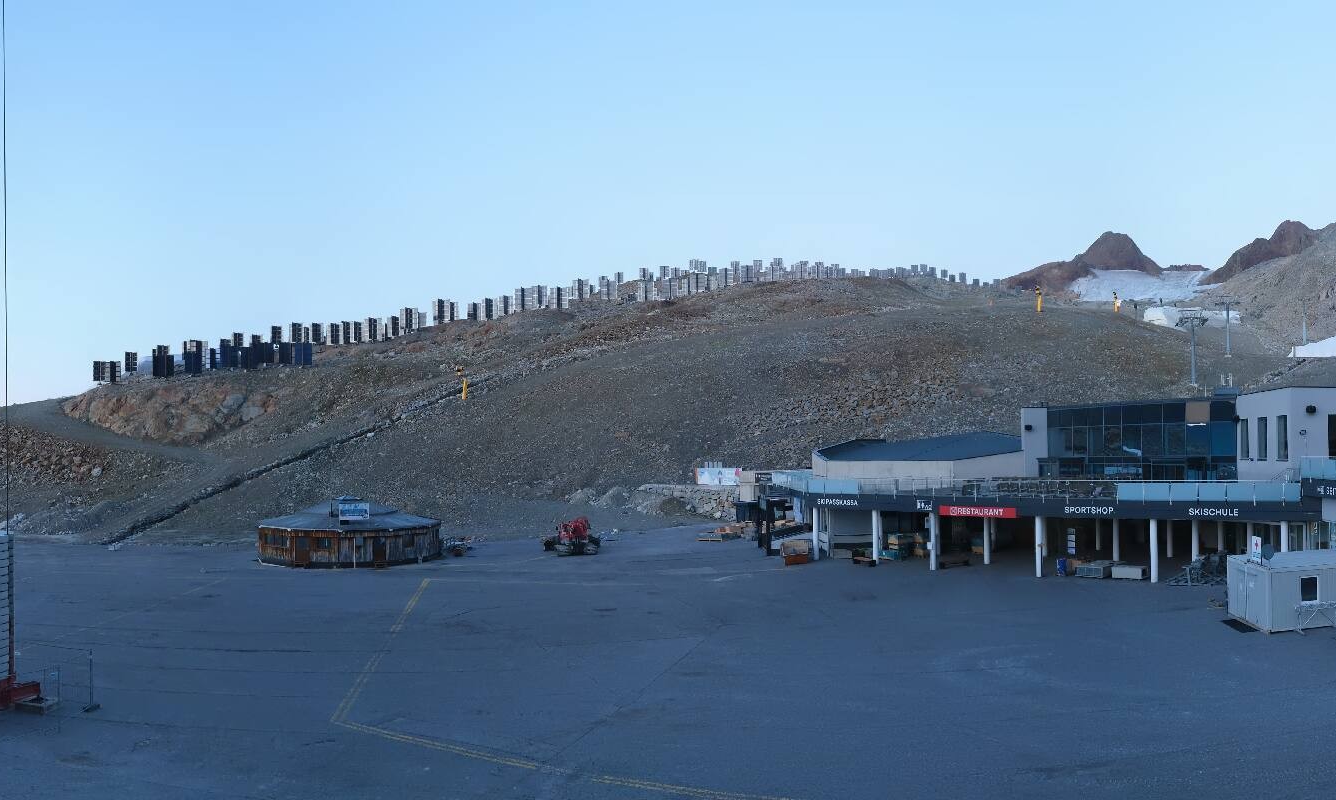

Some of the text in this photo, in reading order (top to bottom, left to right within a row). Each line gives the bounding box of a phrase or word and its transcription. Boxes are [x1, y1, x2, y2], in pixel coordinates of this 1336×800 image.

[817, 498, 858, 506] SKIPASSKASSA
[957, 507, 1004, 516] RESTAURANT
[1064, 506, 1114, 515] SPORTSHOP
[1188, 507, 1239, 516] SKISCHULE
